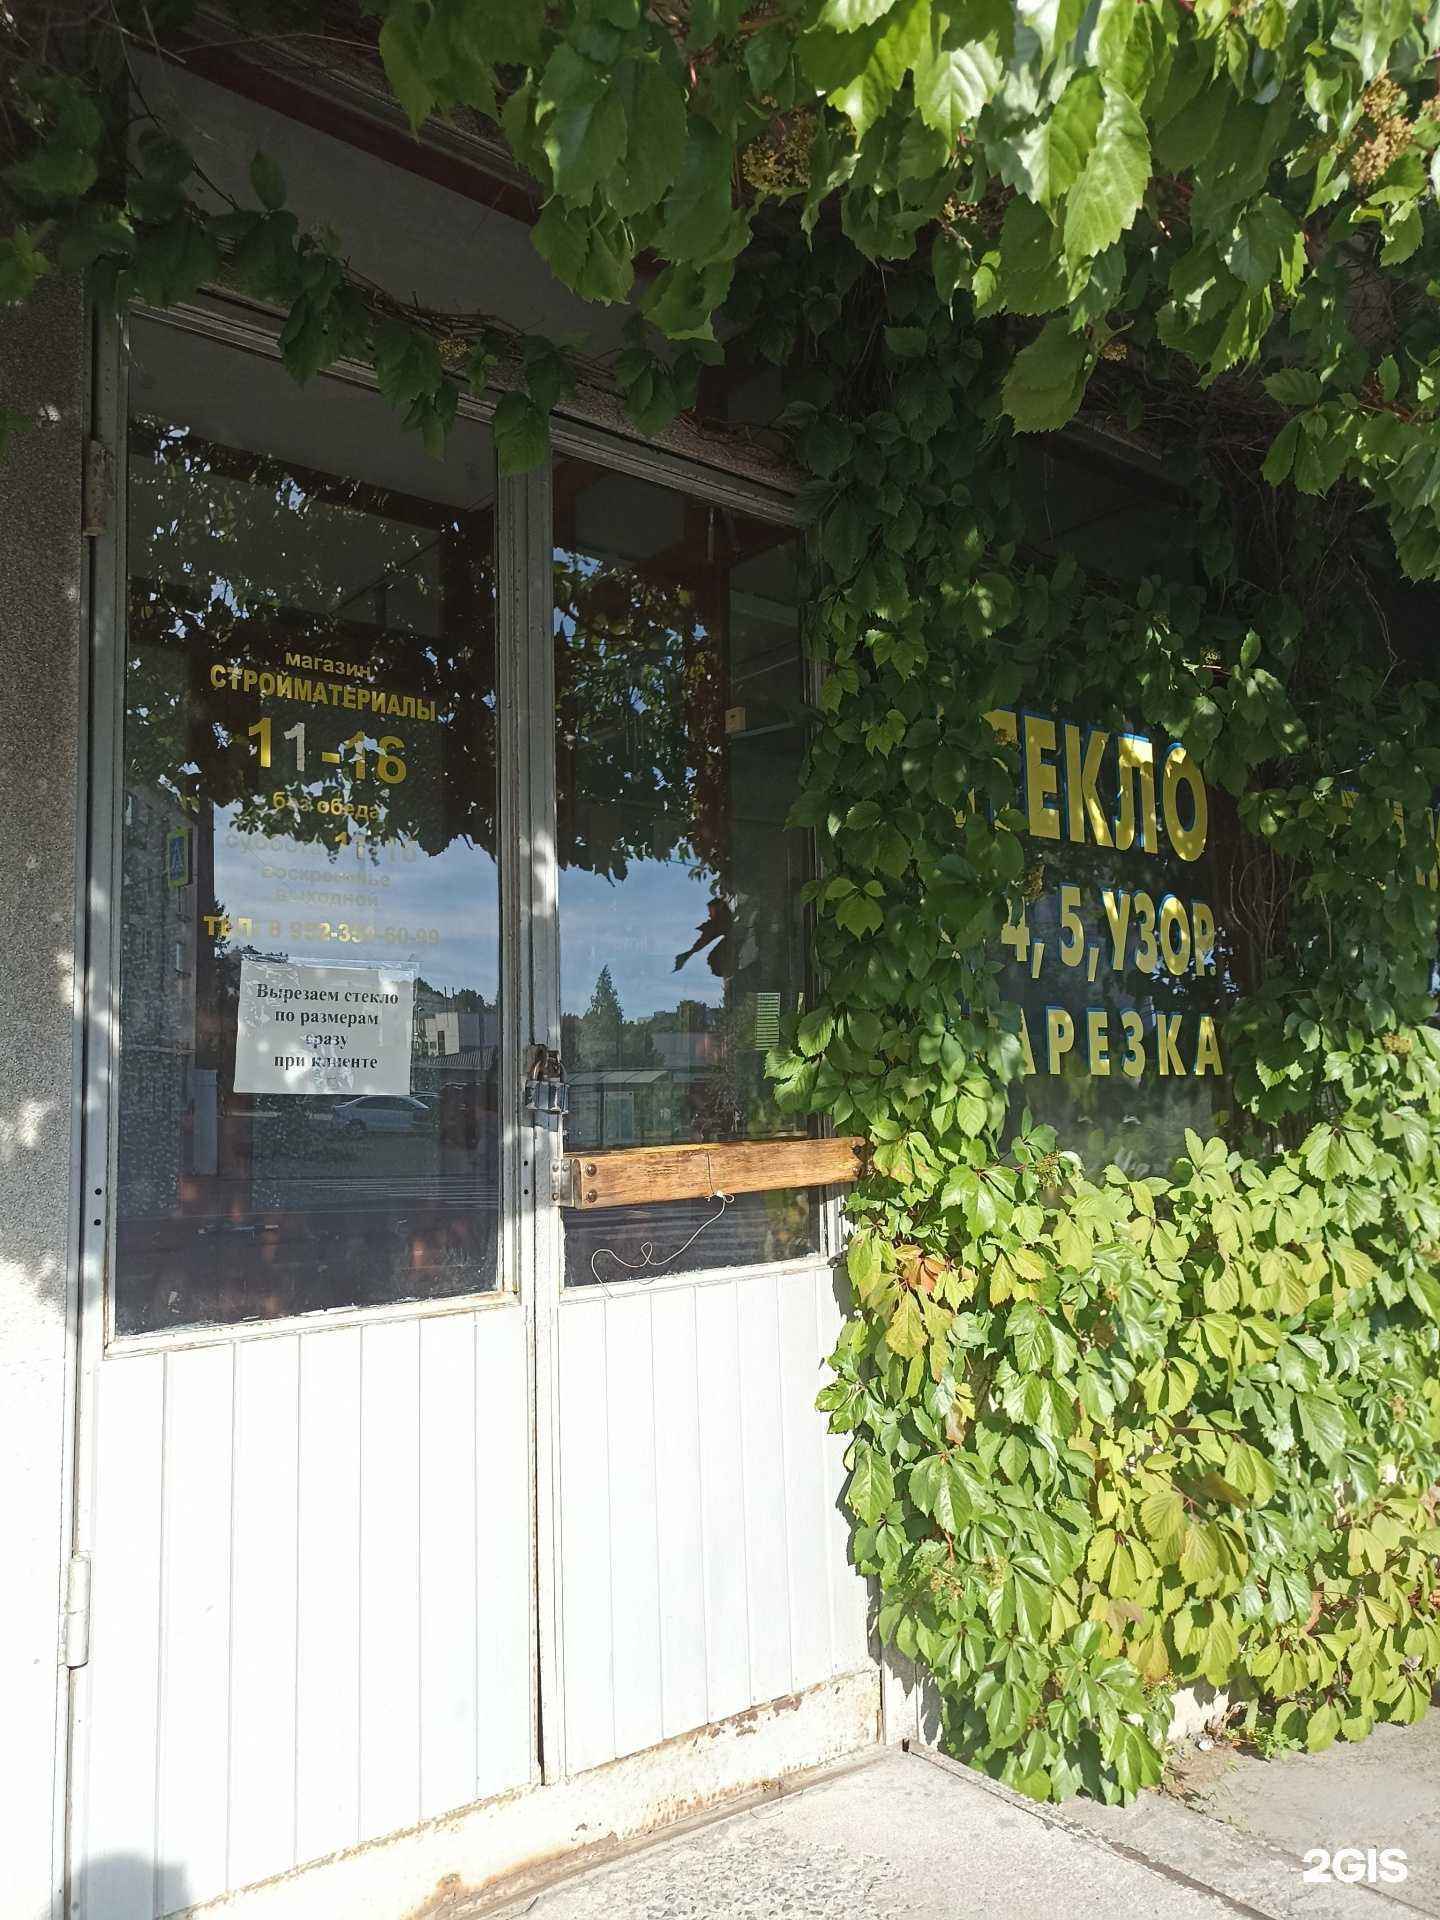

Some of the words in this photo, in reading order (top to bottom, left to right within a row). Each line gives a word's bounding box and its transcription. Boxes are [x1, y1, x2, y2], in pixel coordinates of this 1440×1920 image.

[285, 652, 371, 679] магазин
[210, 664, 436, 722] СТРОЙМАТЕРИАЛЫ
[248, 716, 407, 785] 11-16
[256, 983, 339, 1003] Вырезаем
[344, 993, 399, 1005] стекло
[275, 1010, 295, 1022] по
[300, 1011, 378, 1027] размерам
[305, 1032, 348, 1049] сразу
[274, 1056, 305, 1071] при
[311, 1057, 378, 1069] клиенте
